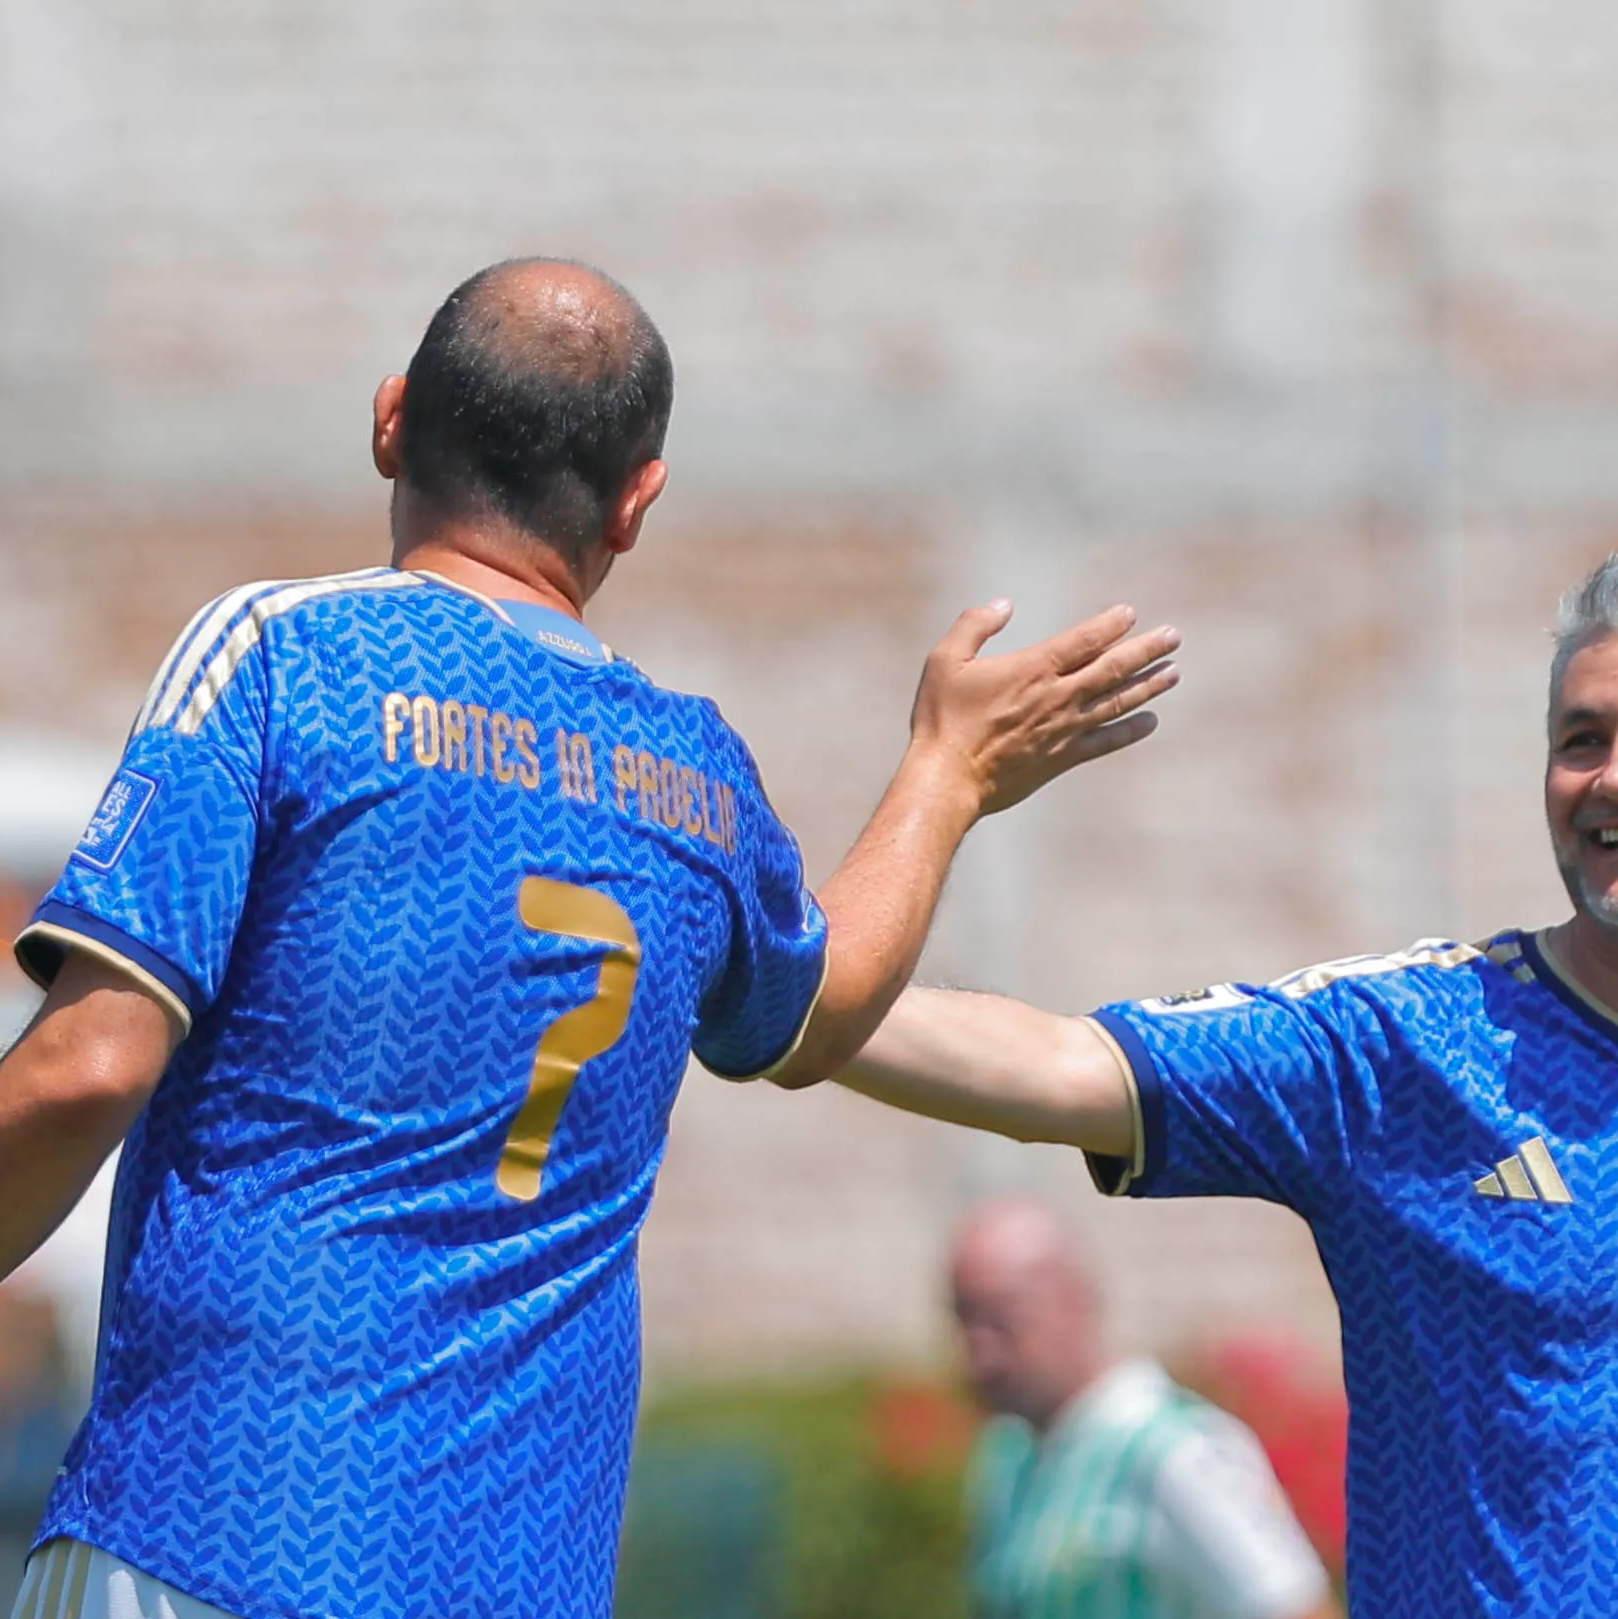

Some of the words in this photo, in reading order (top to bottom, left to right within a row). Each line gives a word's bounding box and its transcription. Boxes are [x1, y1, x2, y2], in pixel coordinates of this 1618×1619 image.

[384, 692, 541, 789] FORTES
[556, 727, 598, 804] IN
[496, 874, 641, 1202] 7
